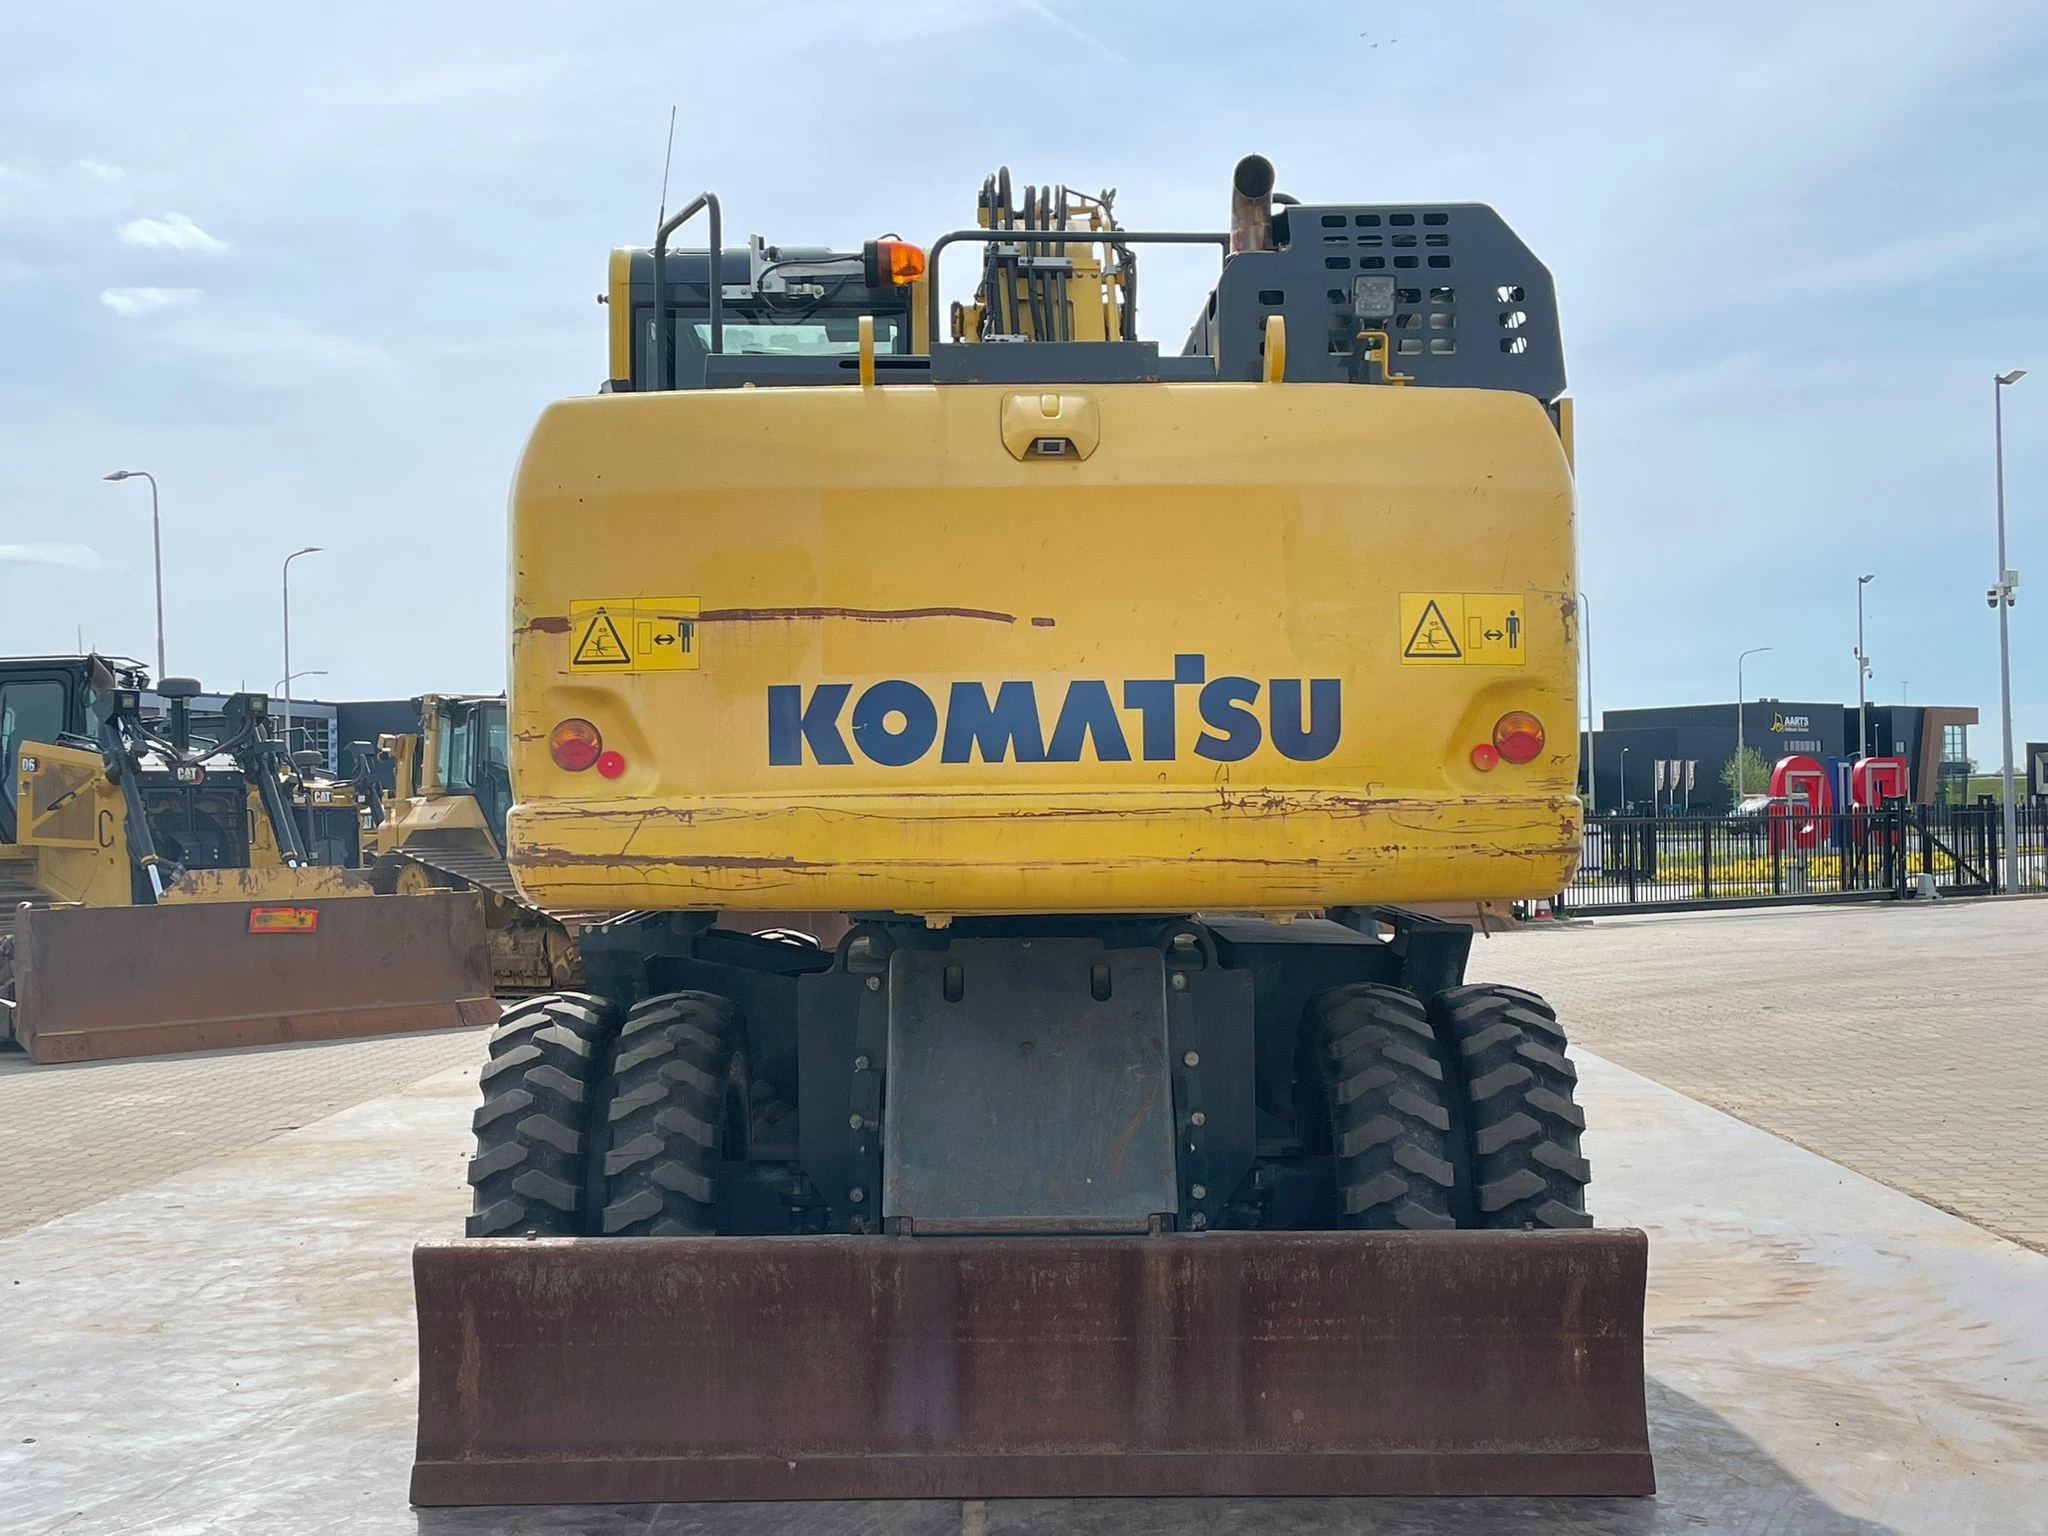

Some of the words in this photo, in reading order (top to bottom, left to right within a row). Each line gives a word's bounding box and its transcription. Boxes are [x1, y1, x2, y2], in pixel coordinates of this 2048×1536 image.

[767, 653, 1341, 766] KOMATSU
[1784, 716, 1809, 726] AARTS
[22, 758, 36, 771] D6
[177, 767, 197, 780] CAT
[314, 791, 331, 802] CAT
